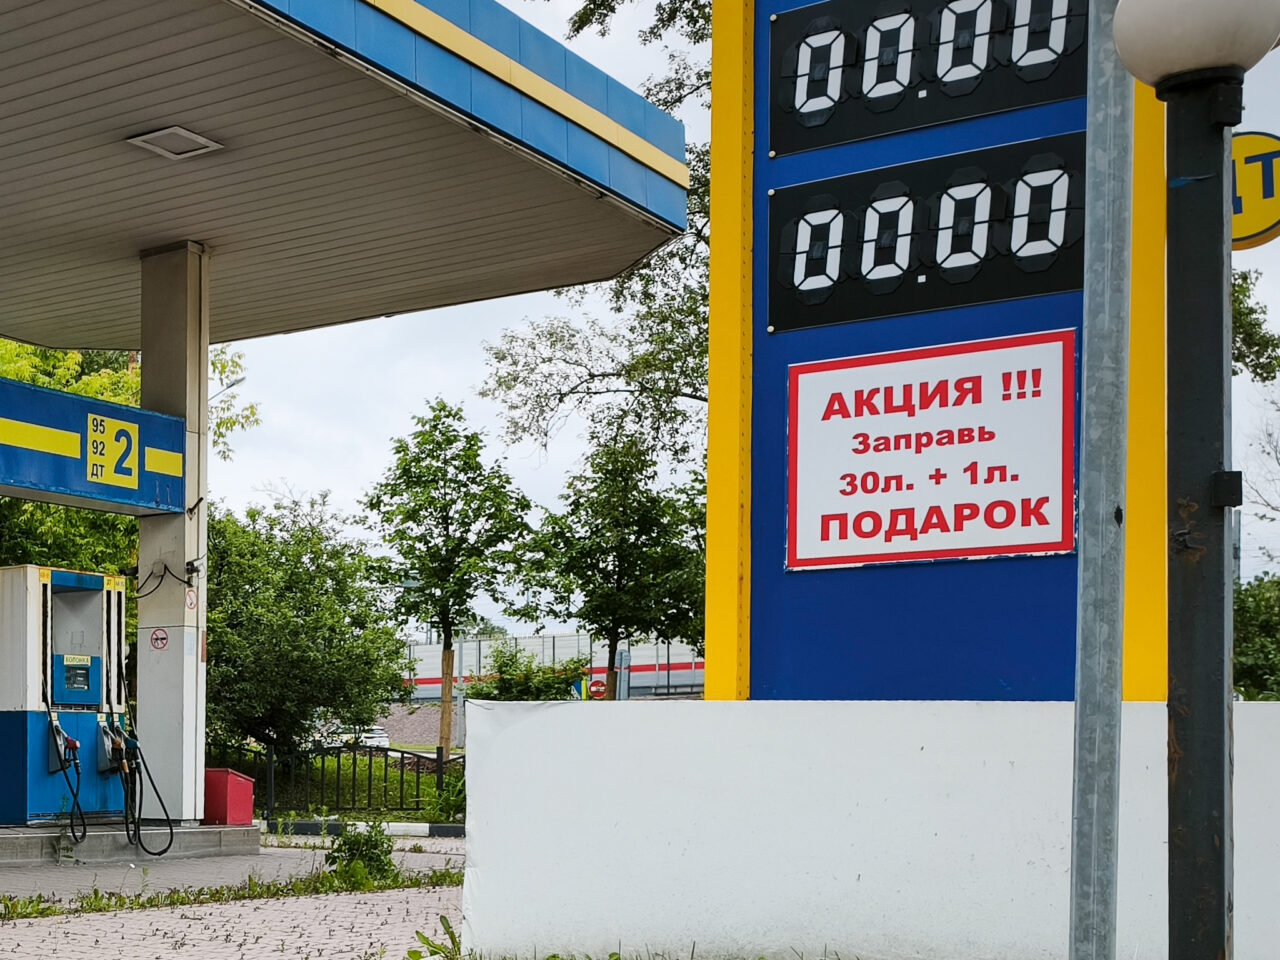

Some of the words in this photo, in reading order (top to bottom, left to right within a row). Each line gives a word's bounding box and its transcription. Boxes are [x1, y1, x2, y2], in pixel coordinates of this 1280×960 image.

[793, 169, 1069, 291] 00.00
[821, 375, 982, 421] АКЦИЯ
[92, 418, 105, 434] 95
[851, 424, 996, 455] Заправь
[92, 440, 105, 456] 92
[114, 428, 133, 477] 2
[91, 463, 105, 479] ДТ
[839, 471, 915, 496] 30л.
[963, 461, 1019, 486] 1л.
[820, 496, 1050, 542] ПОДАРОК
